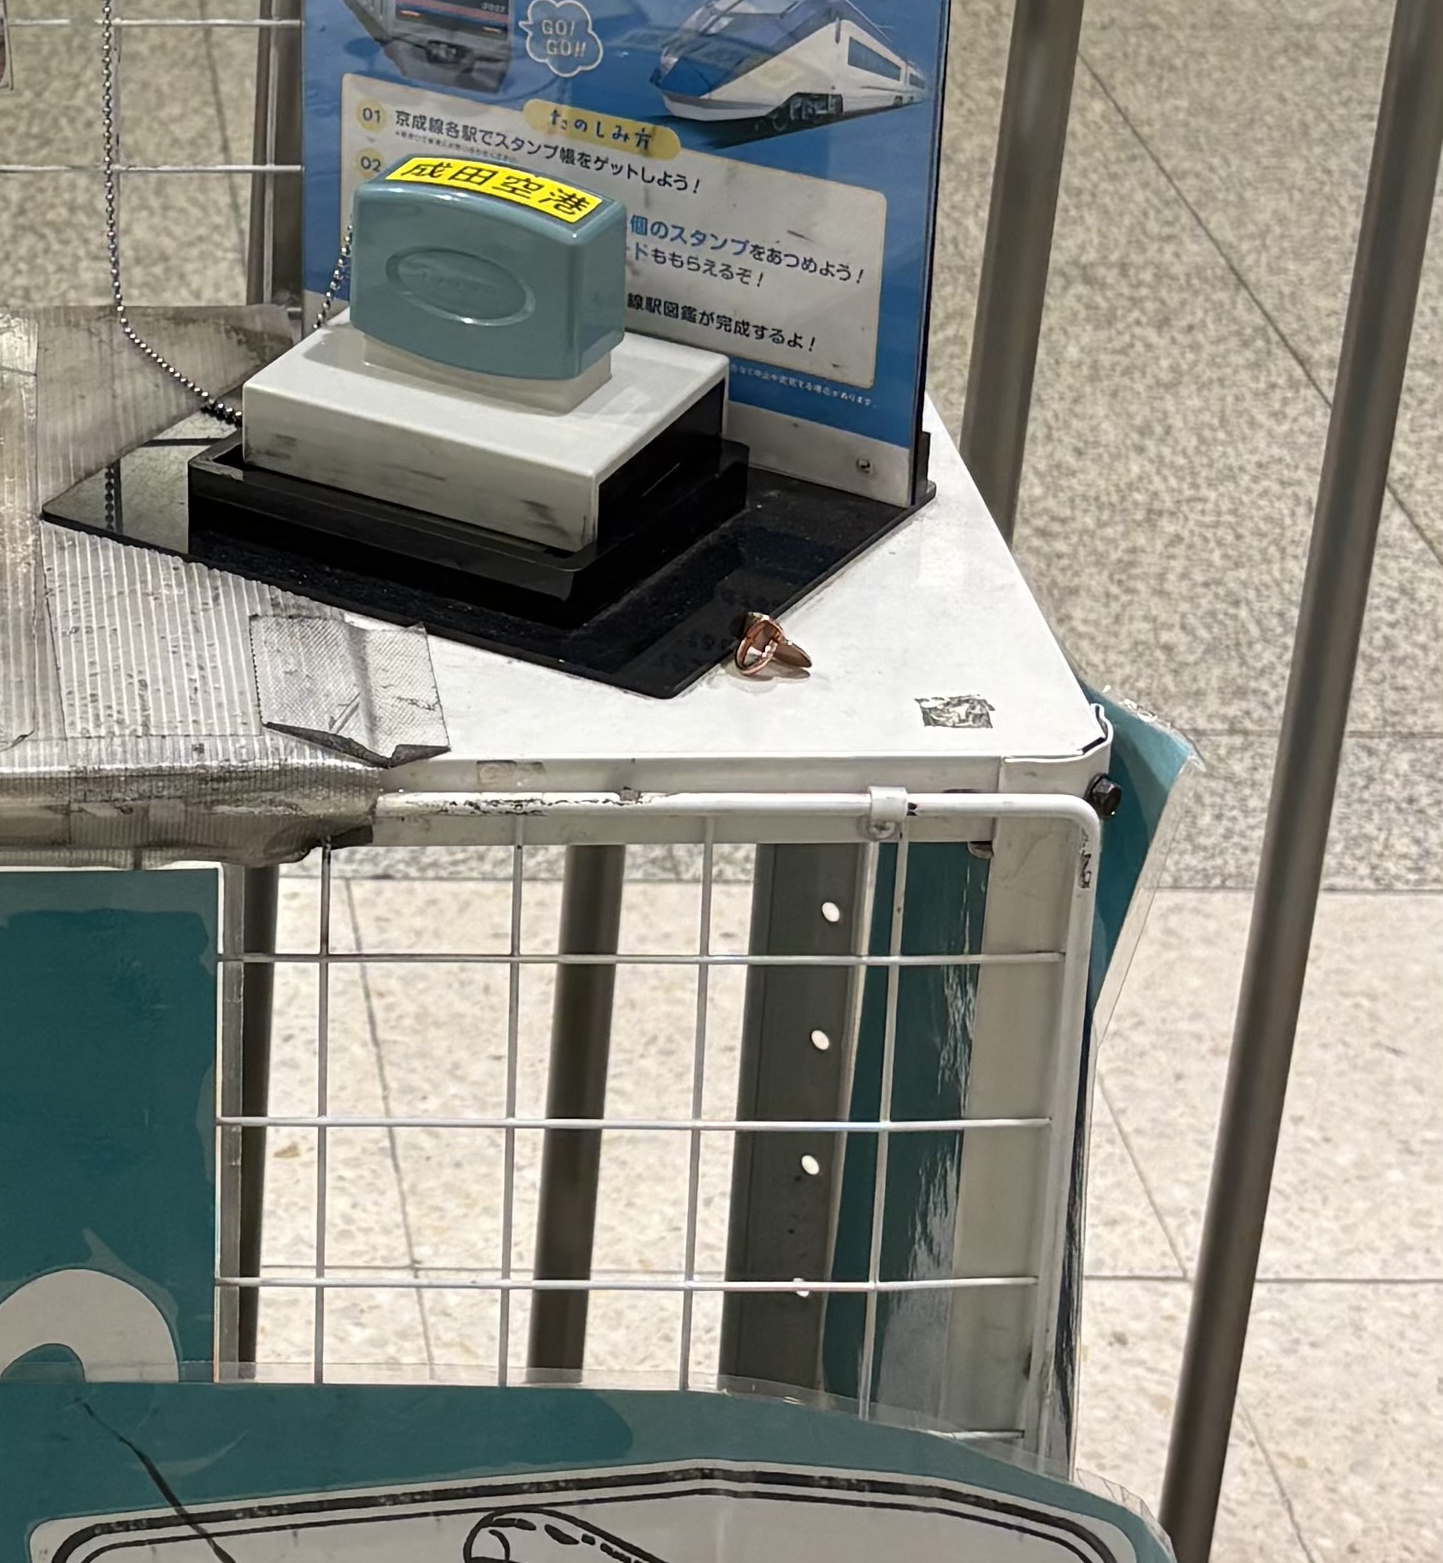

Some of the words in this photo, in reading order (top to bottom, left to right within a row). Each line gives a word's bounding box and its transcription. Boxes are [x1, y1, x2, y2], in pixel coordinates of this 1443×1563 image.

[542, 19, 575, 35] GO!
[362, 107, 383, 125] 01
[550, 109, 653, 151] たのしみ方
[360, 156, 381, 173] 02
[401, 161, 590, 216] 成田空港
